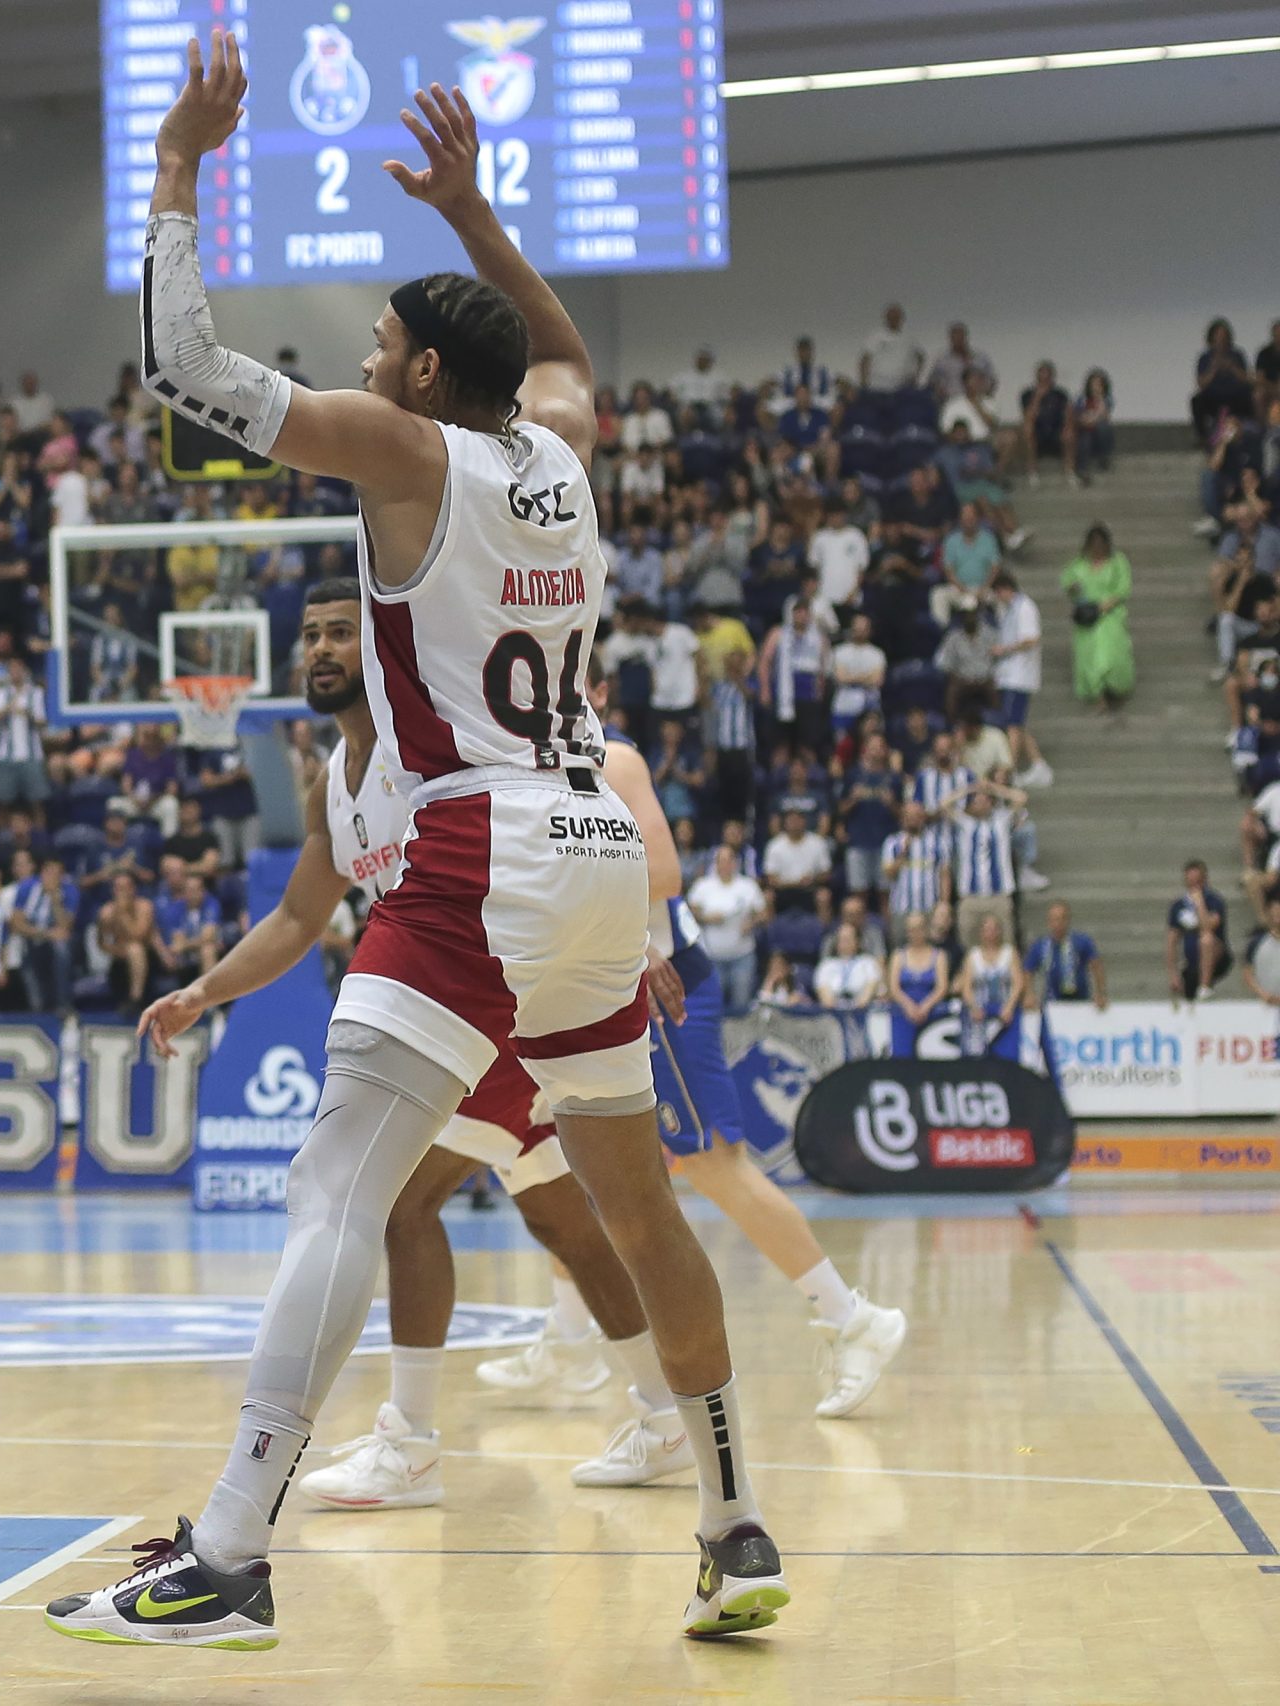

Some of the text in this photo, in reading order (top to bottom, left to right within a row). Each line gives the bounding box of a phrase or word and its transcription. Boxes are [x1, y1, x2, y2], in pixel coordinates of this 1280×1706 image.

[316, 147, 350, 214] 2
[476, 138, 531, 206] 12
[286, 231, 384, 268] FC PORTO
[500, 567, 586, 606] ALMEIDA
[922, 1080, 1010, 1128] LIGA
